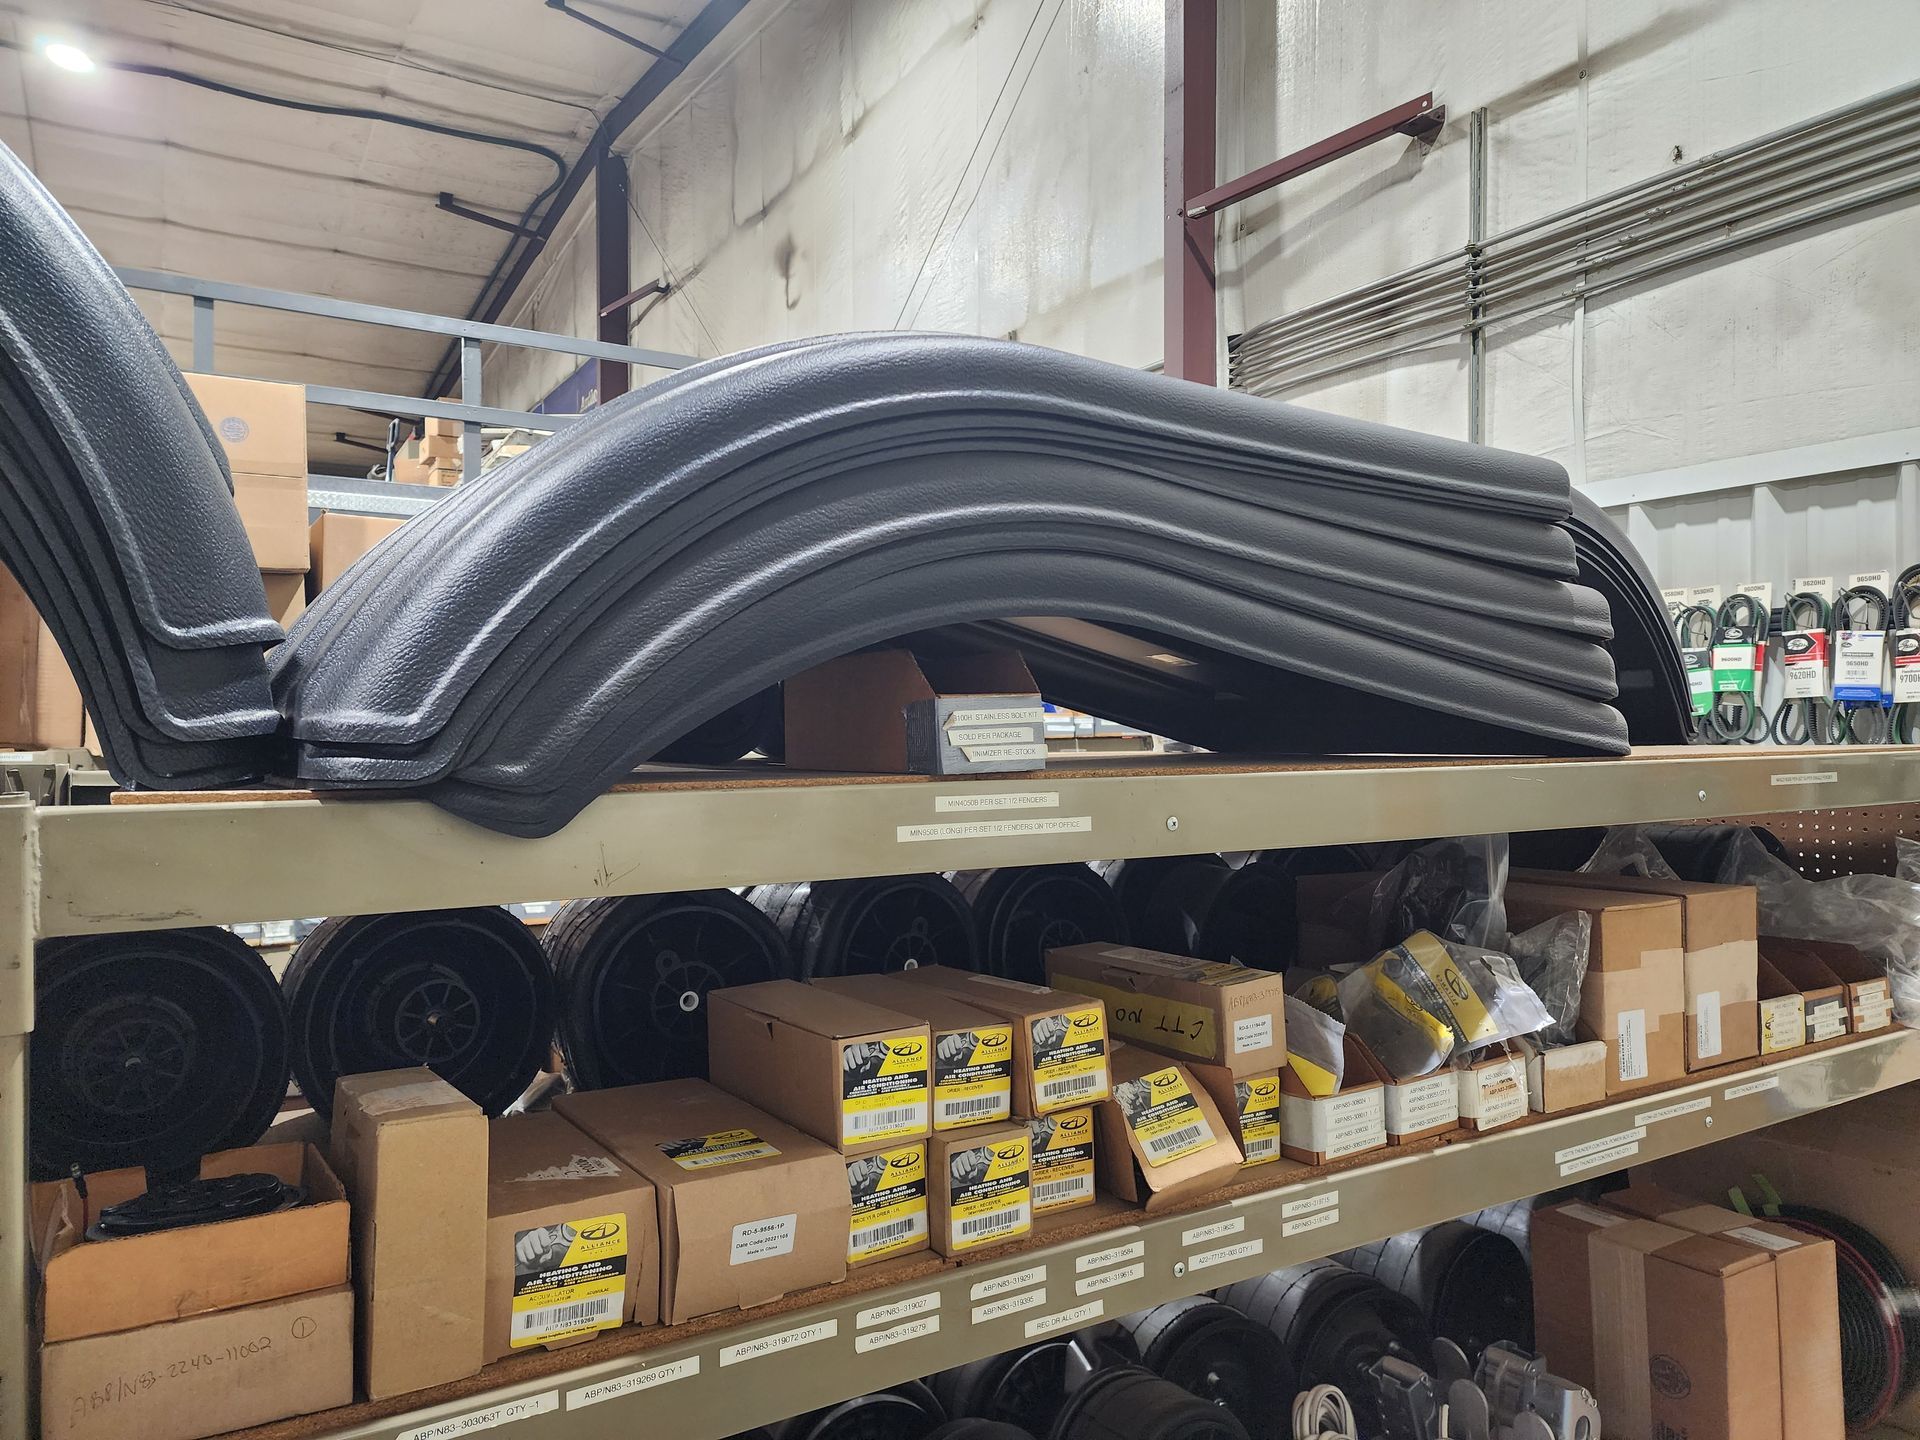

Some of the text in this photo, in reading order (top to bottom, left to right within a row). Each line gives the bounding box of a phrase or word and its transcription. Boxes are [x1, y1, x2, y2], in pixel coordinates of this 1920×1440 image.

[1790, 670, 1816, 680] 9620HD
[975, 712, 1010, 721] STAINLESS
[958, 731, 1022, 741] SOLD PER PACKAGE
[1018, 796, 1048, 804] FENDERS
[1003, 824, 1033, 832] FENDERS
[1074, 1026, 1100, 1034] ALLIANCE
[982, 1046, 1008, 1054] ALLIANCE
[1048, 1047, 1074, 1056] HEATING
[1054, 1047, 1096, 1059] CONDITIONING
[892, 1056, 923, 1064] ALLIANCE
[954, 1066, 980, 1074] HEATING
[958, 1068, 1002, 1078] CONDITIONING
[862, 1077, 892, 1085] HEATING
[867, 1078, 918, 1089] CONDITIONING
[1158, 1083, 1183, 1094] ALLIANCE
[1141, 1104, 1165, 1115] HEATING
[1148, 1101, 1188, 1118] CONDITIONING
[1240, 1114, 1272, 1124] ONDITIONING
[1033, 1150, 1060, 1158] HEATING
[1038, 1151, 1084, 1162] CONDITIONING
[998, 1157, 1024, 1169] ALLIANCE
[890, 1165, 920, 1176] ALLIANCE
[969, 1180, 997, 1191] HEATING
[974, 1179, 1021, 1194] CONDITIONING
[861, 1185, 907, 1201] HEATING AND
[866, 1188, 916, 1204] CONDITIONING
[852, 1214, 876, 1224] RECEVER
[580, 1239, 621, 1250] ALLIANCE
[540, 1262, 601, 1278] HEATING AND
[526, 1265, 613, 1287] AIR CONDITIONING
[573, 1316, 594, 1326] 319269
[1061, 1314, 1073, 1324] ALL
[1074, 1310, 1087, 1321] QTY
[800, 1329, 816, 1340] QTY
[584, 1373, 657, 1400] ABP/N83-319269
[658, 1367, 676, 1379] QTY
[413, 1410, 502, 1440] ABP/N83-303063T
[506, 1403, 527, 1417] QTY
